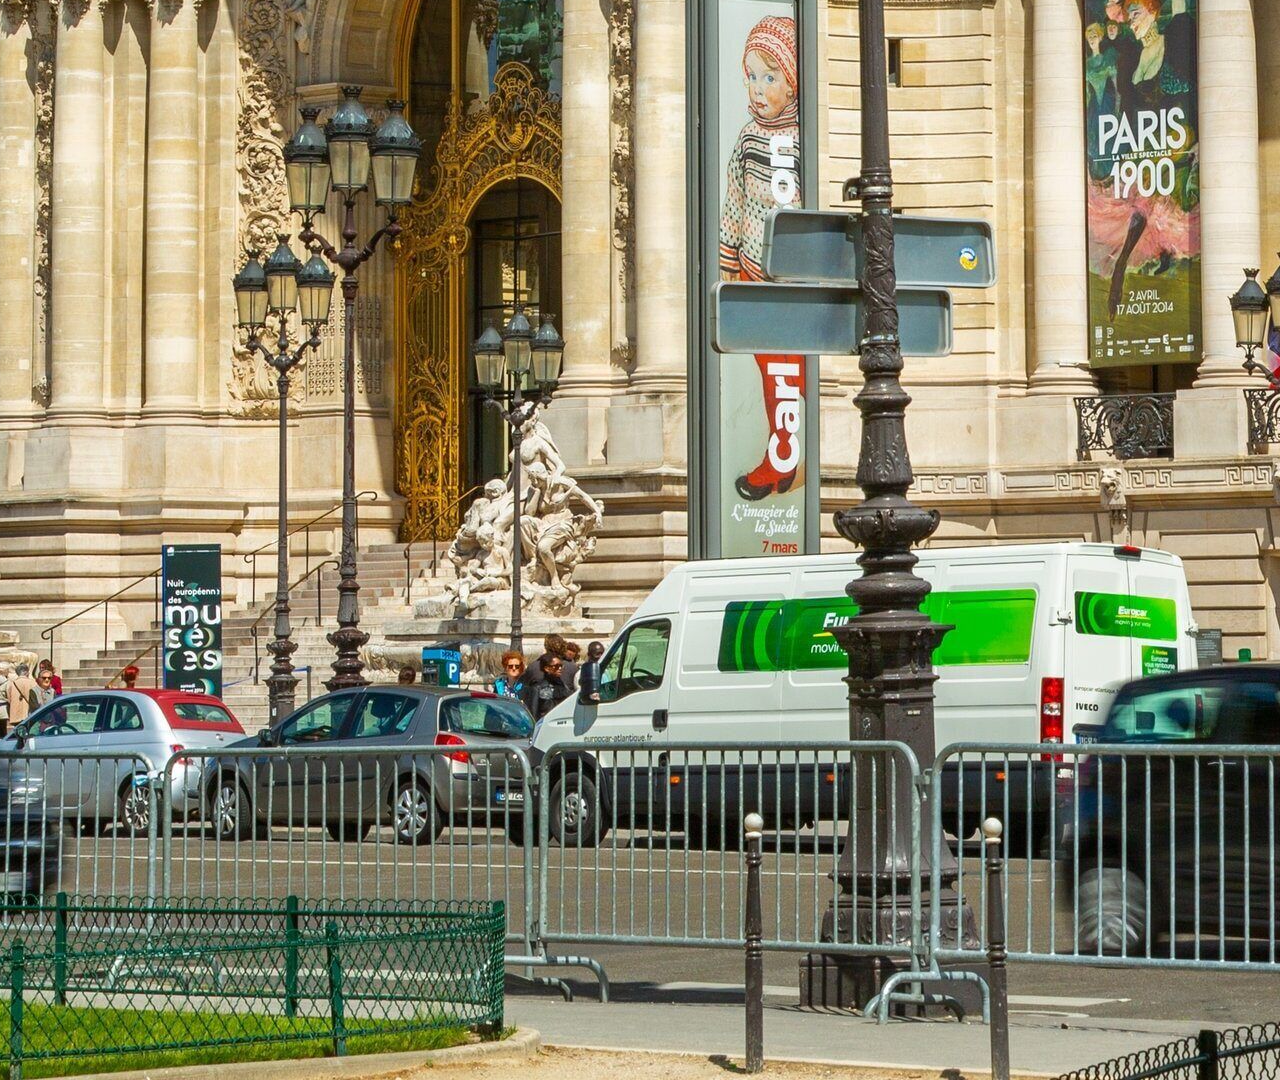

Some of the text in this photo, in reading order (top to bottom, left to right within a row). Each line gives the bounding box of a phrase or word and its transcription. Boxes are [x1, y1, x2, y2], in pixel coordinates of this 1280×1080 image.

[1098, 107, 1187, 156] PARIS
[1121, 152, 1138, 160] VILLE
[1139, 149, 1173, 159] SPECTACLE
[1110, 157, 1175, 200] 1900
[1129, 289, 1160, 302] 2 AVRIL
[1116, 301, 1174, 315] 17 AOÛT 2014
[767, 362, 800, 474] Carl
[785, 504, 799, 519] de
[754, 519, 799, 537] la Suède
[762, 541, 798, 554] 7 mars
[167, 579, 184, 587] Nuit
[168, 596, 182, 604] des
[1117, 605, 1148, 617] Europcar
[1151, 655, 1169, 663] Europcar
[449, 663, 458, 679] P
[1075, 702, 1099, 712] IVECO
